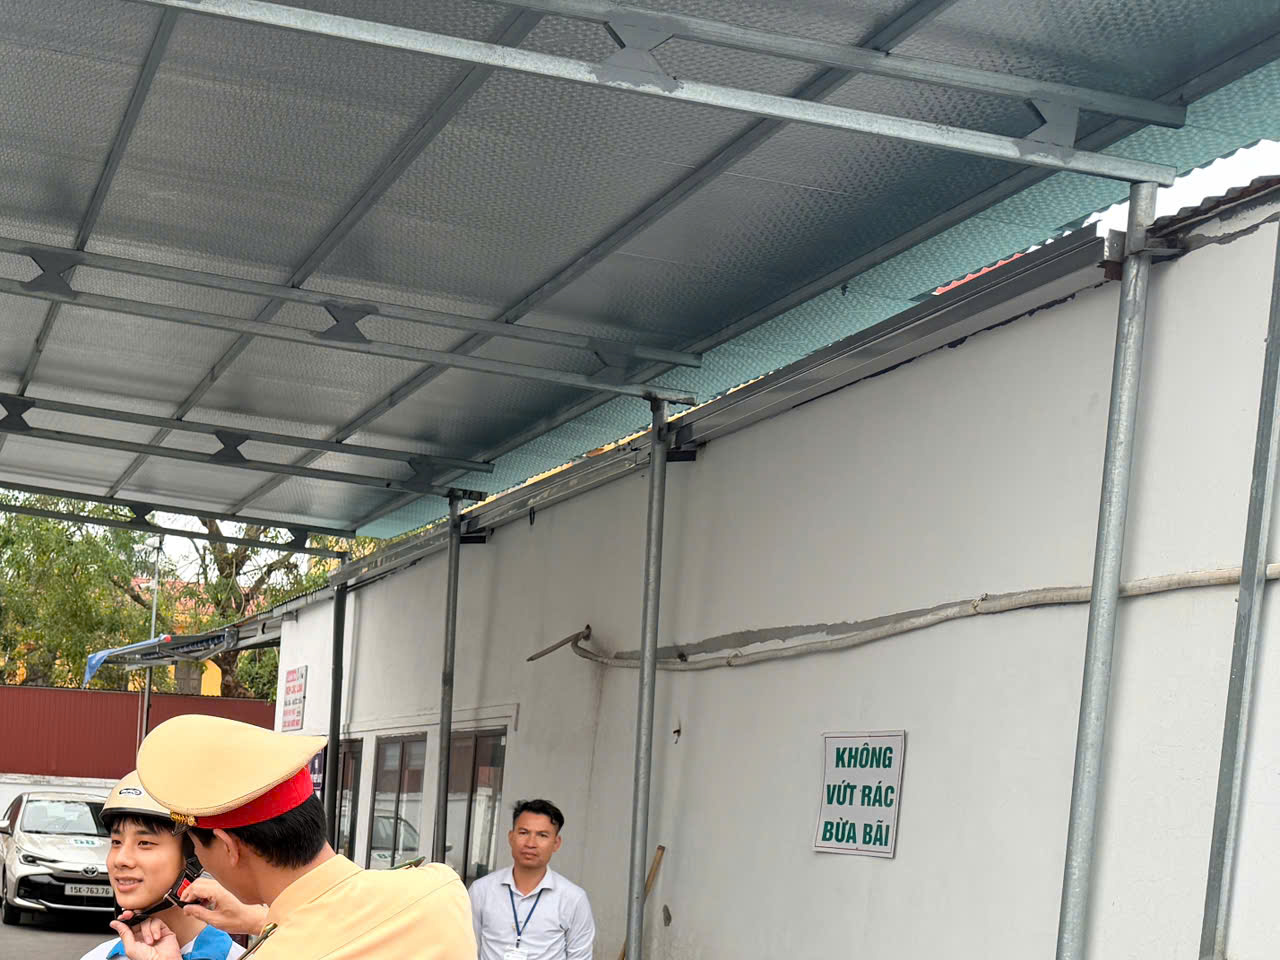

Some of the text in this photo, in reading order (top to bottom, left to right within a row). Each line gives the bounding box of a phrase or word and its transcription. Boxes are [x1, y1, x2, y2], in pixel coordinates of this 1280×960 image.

[835, 742, 893, 769] KHÔNG
[826, 780, 895, 808] VỨT RÁC
[821, 817, 890, 847] BỪA BÃI
